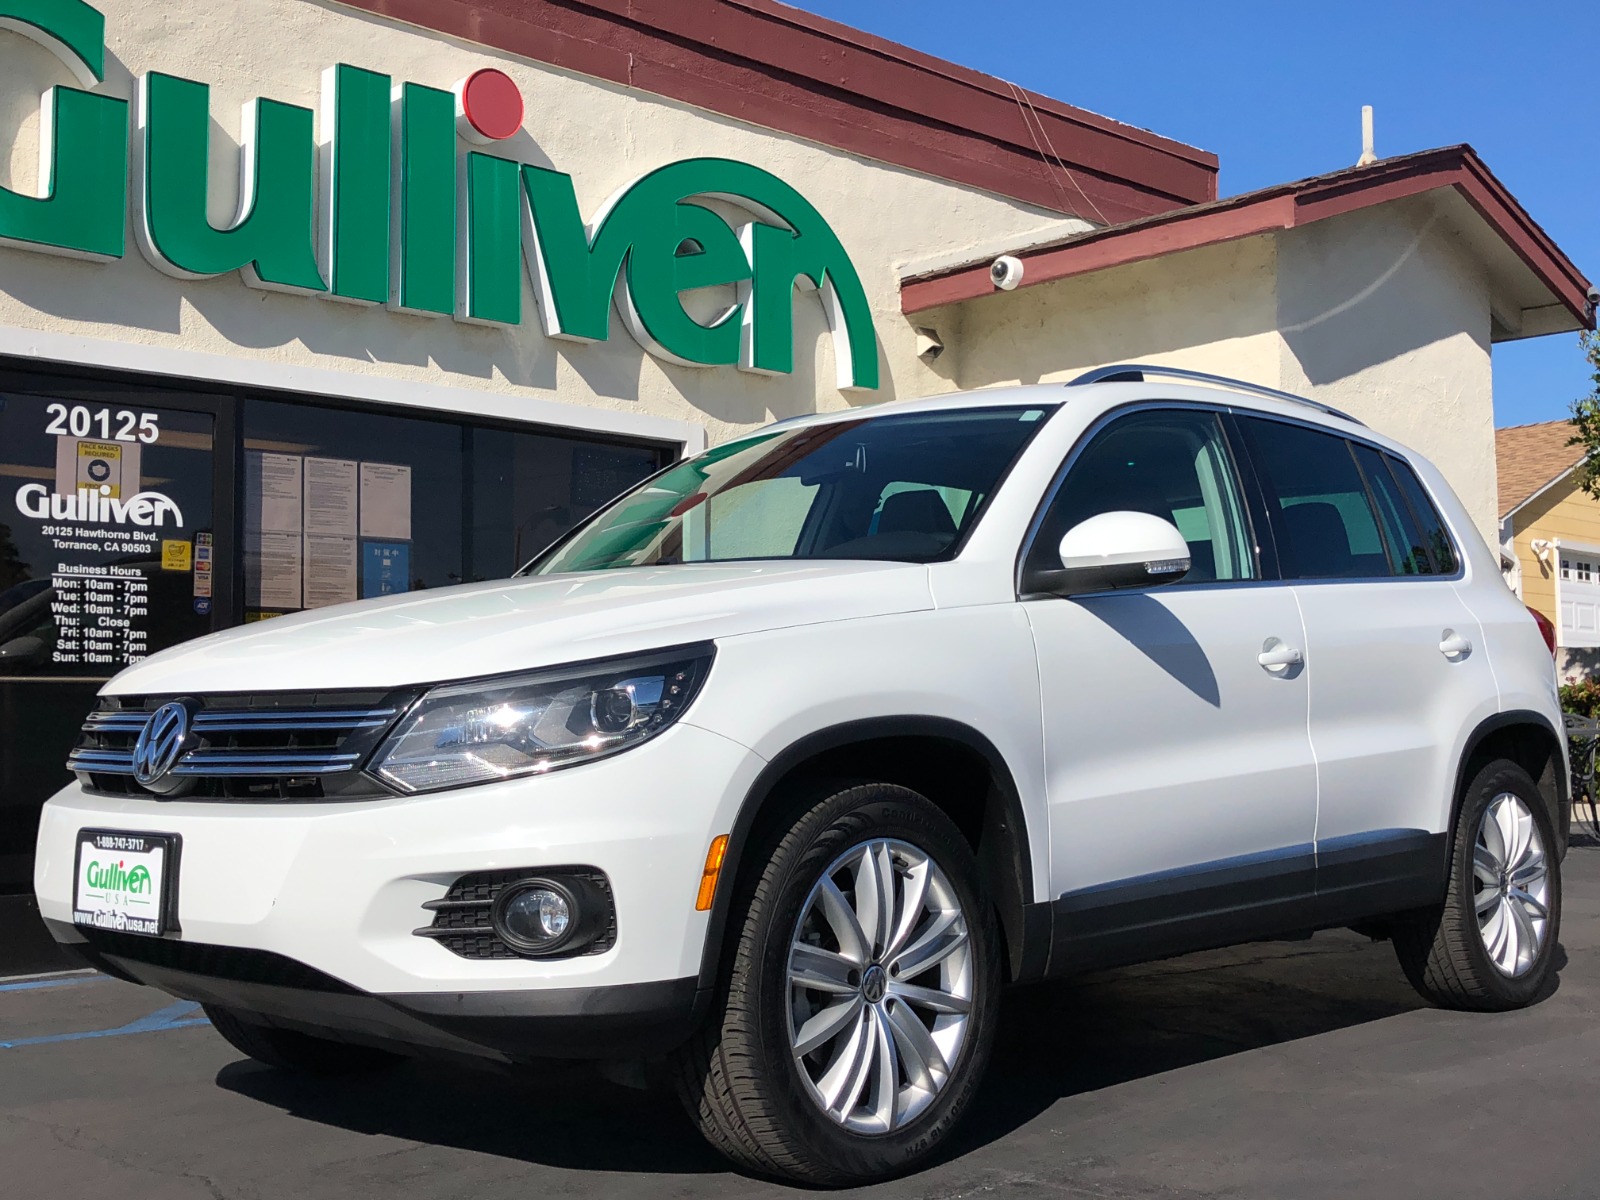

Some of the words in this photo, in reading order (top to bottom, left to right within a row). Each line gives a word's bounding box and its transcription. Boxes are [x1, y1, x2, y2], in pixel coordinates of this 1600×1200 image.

[45, 403, 158, 443] 20125
[84, 450, 115, 458] REQUIRED
[97, 444, 119, 452] MASKS
[16, 483, 183, 527] Gulliver
[42, 526, 72, 536] 20125
[76, 528, 130, 539] Hawthorne
[133, 531, 158, 541] Blvd.
[53, 540, 101, 552] Torrance,
[104, 542, 119, 551] CA
[122, 543, 151, 553] 90503
[58, 563, 107, 574] Business
[110, 566, 141, 576] Hours
[52, 578, 80, 588] Mon:
[84, 579, 114, 590] 10am
[124, 581, 147, 593] 7pm
[56, 590, 80, 600] Tue:
[84, 592, 113, 602] 10am
[123, 593, 147, 605] 7pm
[51, 603, 80, 613] Wed:
[84, 604, 113, 614] 10am
[123, 605, 147, 617] 7pm
[54, 615, 80, 625] Thu:
[98, 617, 130, 627] Close
[60, 627, 79, 637] Fri:
[83, 628, 113, 638] 10am
[123, 629, 147, 640] 7pm
[57, 639, 79, 649] Sat:
[83, 640, 112, 650] 10am
[123, 641, 146, 652] 7pm
[52, 652, 79, 662] Sun:
[83, 652, 112, 663] 10am
[87, 860, 151, 895] Gulliver
[74, 909, 158, 934] www.Gulliverusa.net
